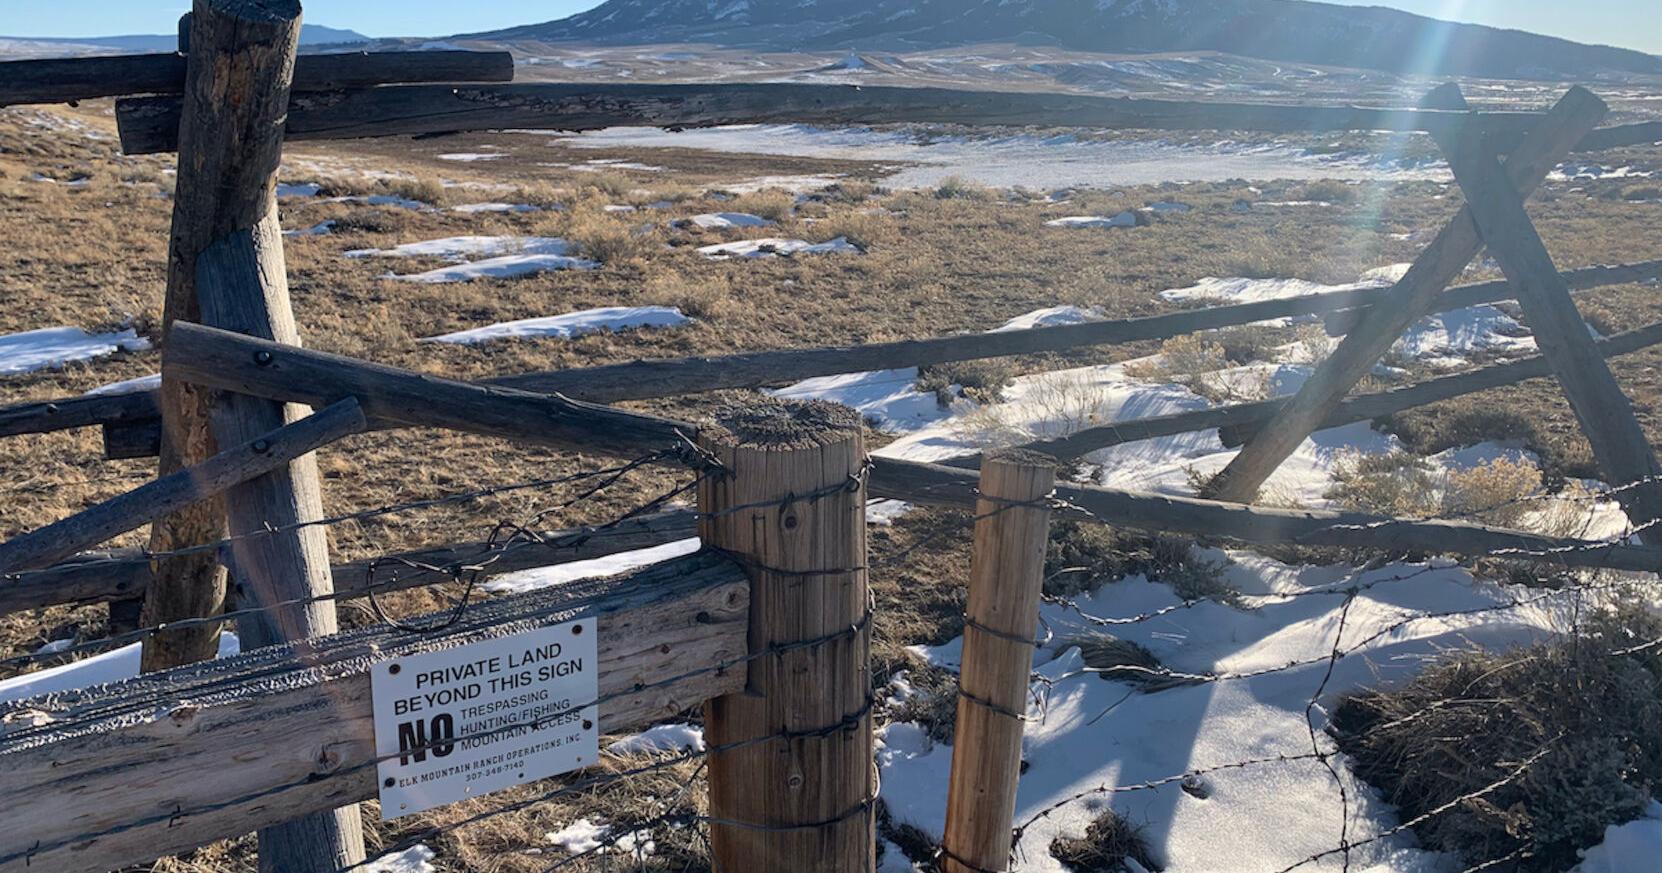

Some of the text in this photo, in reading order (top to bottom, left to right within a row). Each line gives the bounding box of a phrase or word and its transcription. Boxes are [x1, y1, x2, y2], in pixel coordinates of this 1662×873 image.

[415, 642, 562, 690] PRIVATE LAND
[394, 658, 583, 716] BEYOND THIS SIGN
[460, 689, 549, 720] TRESPASSING
[460, 698, 571, 735] HUNTING/FISHING
[398, 713, 455, 766] NO
[461, 725, 527, 752] MOUNTAIN
[399, 775, 418, 788] ELK
[420, 763, 471, 783] MOUNTAIN
[473, 753, 504, 770] RANCH
